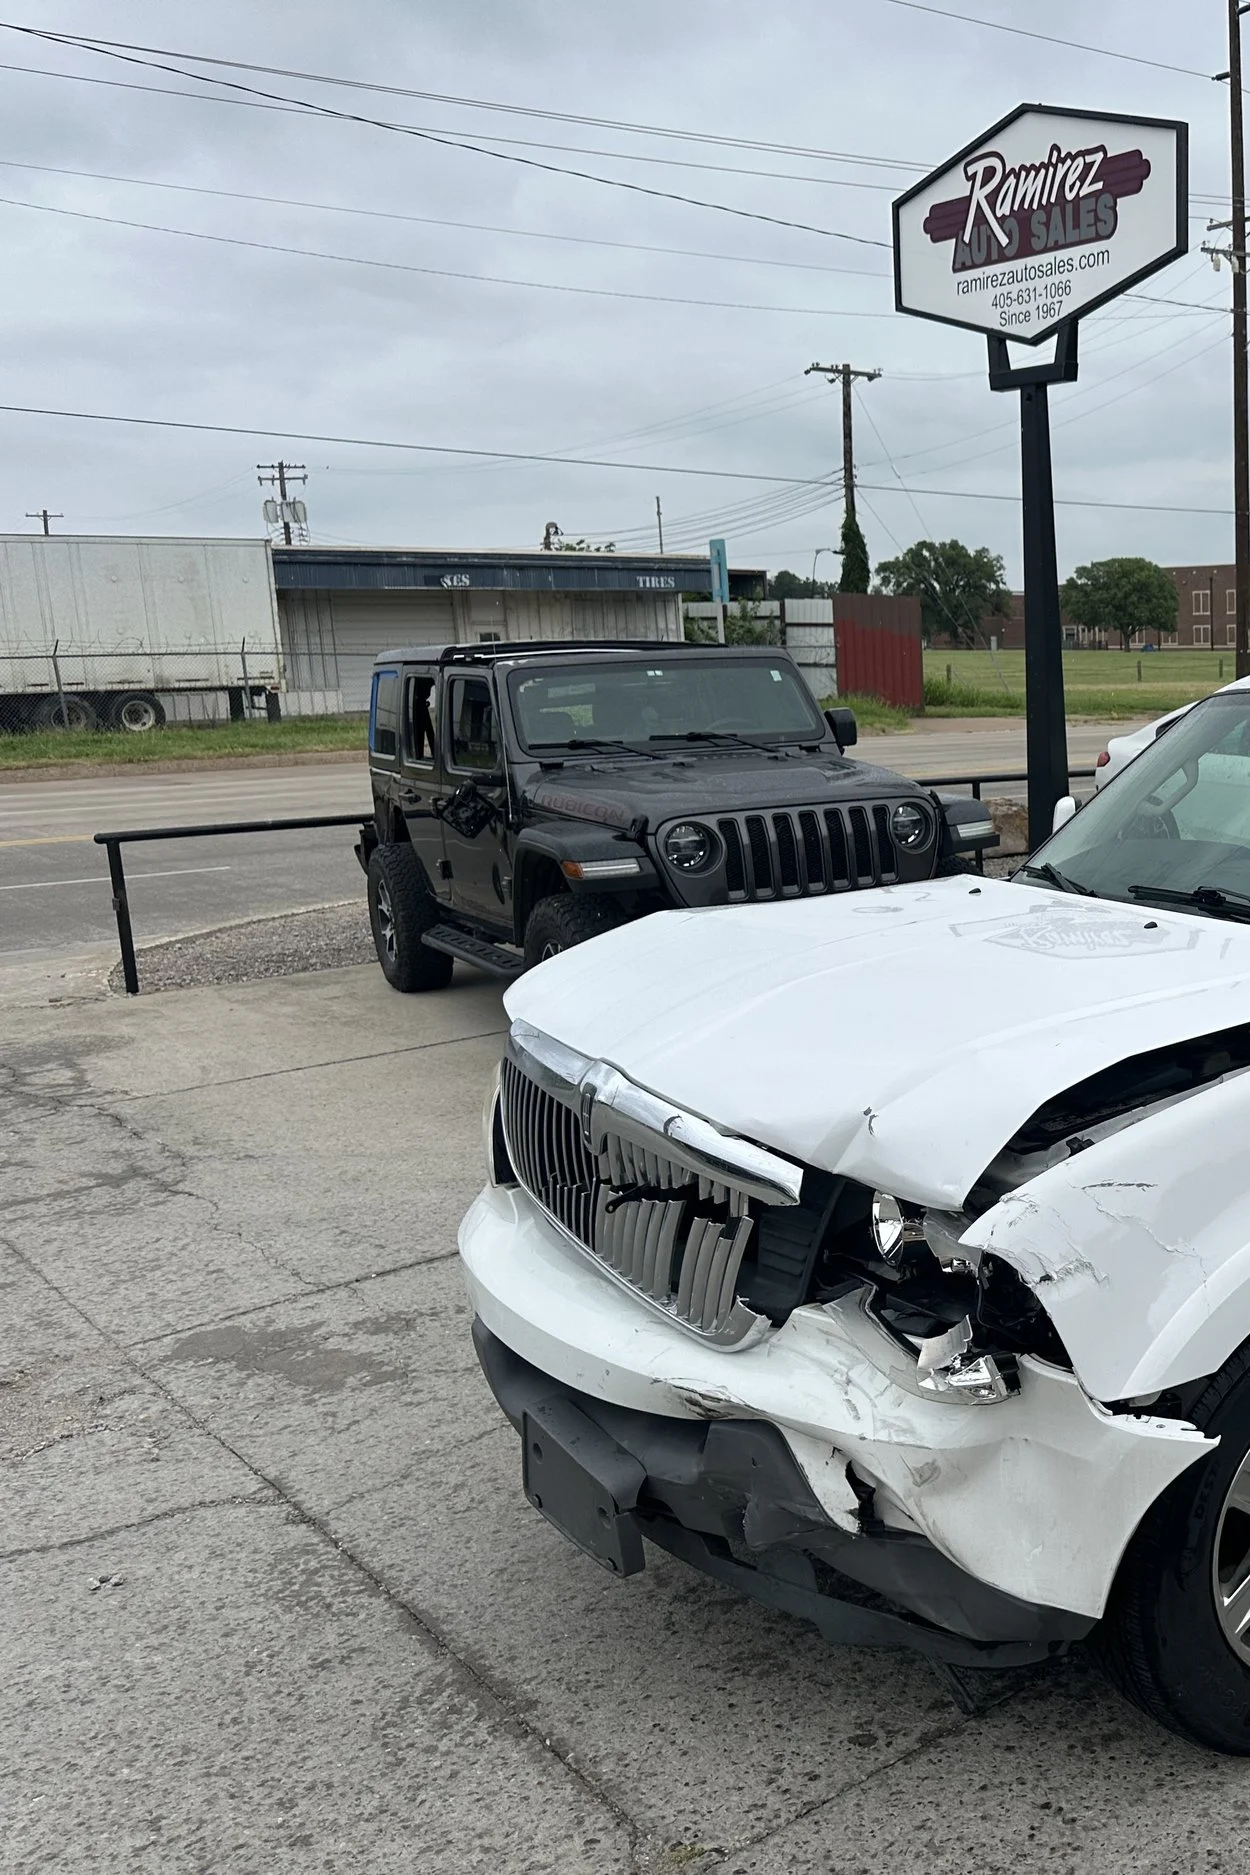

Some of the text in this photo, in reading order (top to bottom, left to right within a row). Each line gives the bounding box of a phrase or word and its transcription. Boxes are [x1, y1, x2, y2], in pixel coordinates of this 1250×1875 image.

[963, 148, 1105, 248] Ramirez
[1030, 193, 1116, 252] SALES
[956, 247, 1110, 297] ramirezautosales.com
[991, 279, 1072, 311] 405-631-1066
[999, 300, 1064, 328] Since 1967
[636, 575, 676, 588] TIRES
[540, 794, 625, 823] RUBICON
